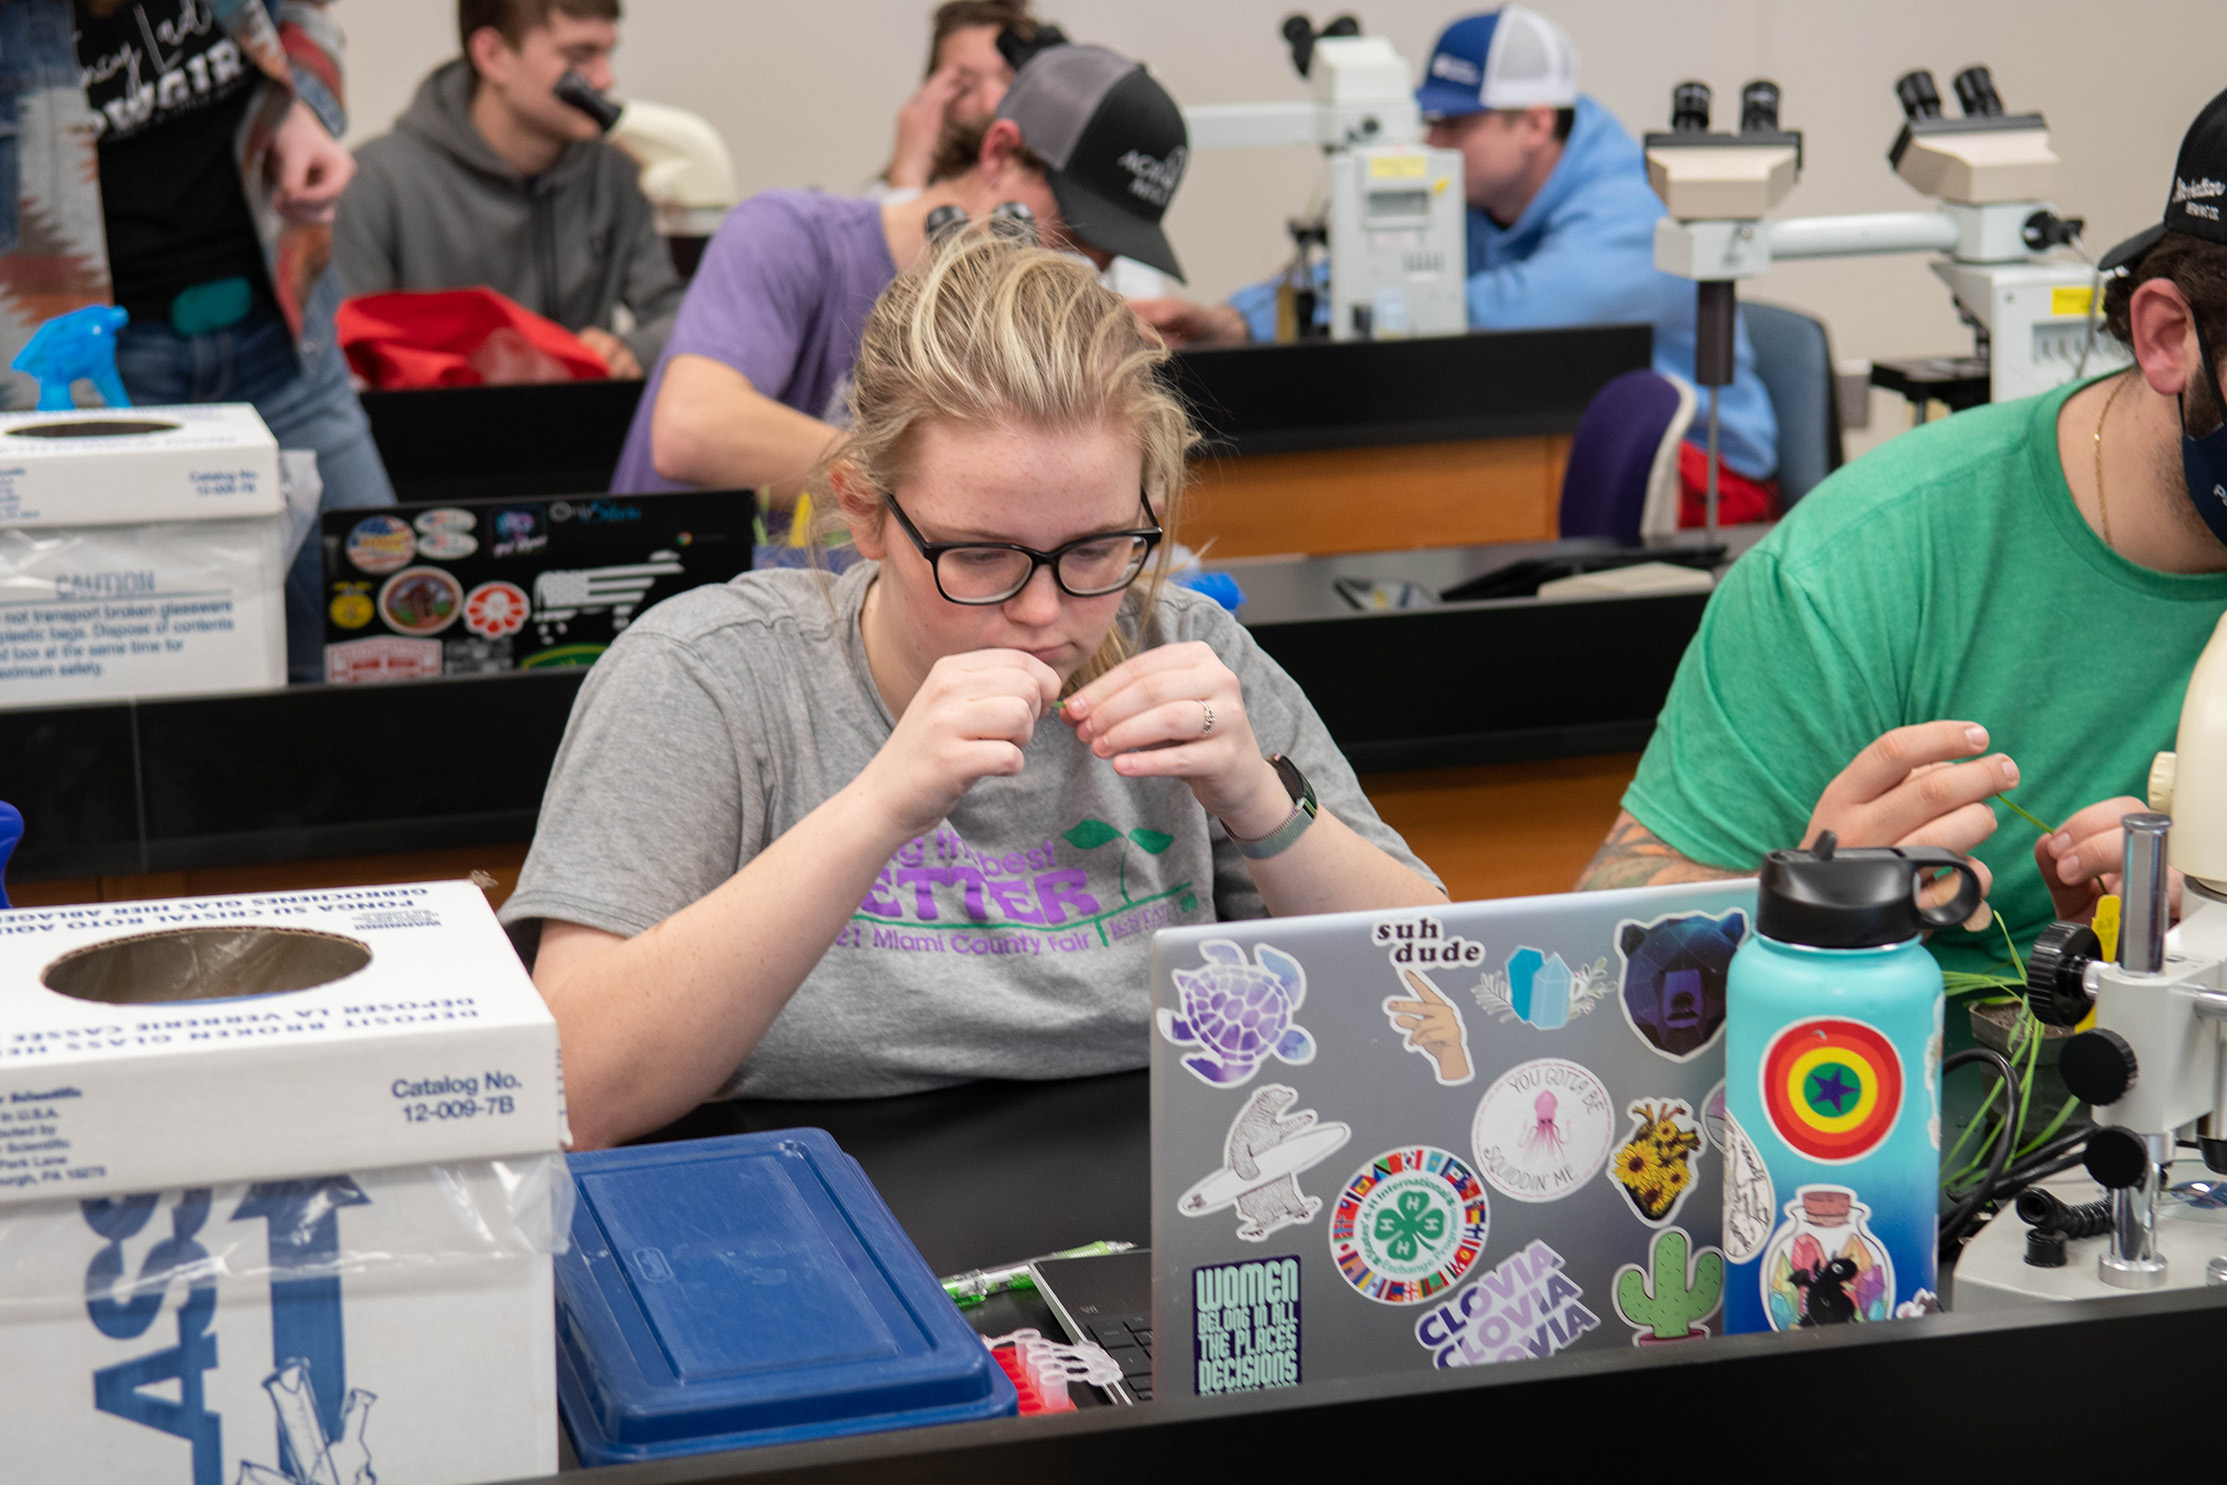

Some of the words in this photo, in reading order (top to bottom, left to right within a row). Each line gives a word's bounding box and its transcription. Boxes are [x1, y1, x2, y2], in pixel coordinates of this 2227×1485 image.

[861, 865, 1100, 925] ETTER
[0, 910, 101, 922] ABLAGE
[0, 924, 55, 935] AQU
[67, 917, 144, 929] ROTO
[1376, 917, 1439, 940] suh
[873, 927, 946, 953] Miami
[951, 932, 1041, 956] County
[1049, 932, 1090, 953] Fair
[1395, 941, 1481, 963] dude
[391, 1075, 479, 1099] Catalog
[485, 1071, 522, 1091] No.
[1507, 1068, 1540, 1095] YOU
[403, 1095, 516, 1123] 12-009-7B
[1196, 1258, 1299, 1312] WOMEN
[1419, 1245, 1562, 1346] CLOVIA
[1198, 1306, 1251, 1334] BELONG
[1253, 1304, 1268, 1329] IN
[1271, 1301, 1299, 1326] ALL
[1198, 1331, 1231, 1361] THE
[1234, 1322, 1298, 1359] PLACES
[1198, 1349, 1298, 1392] DECISIONS
